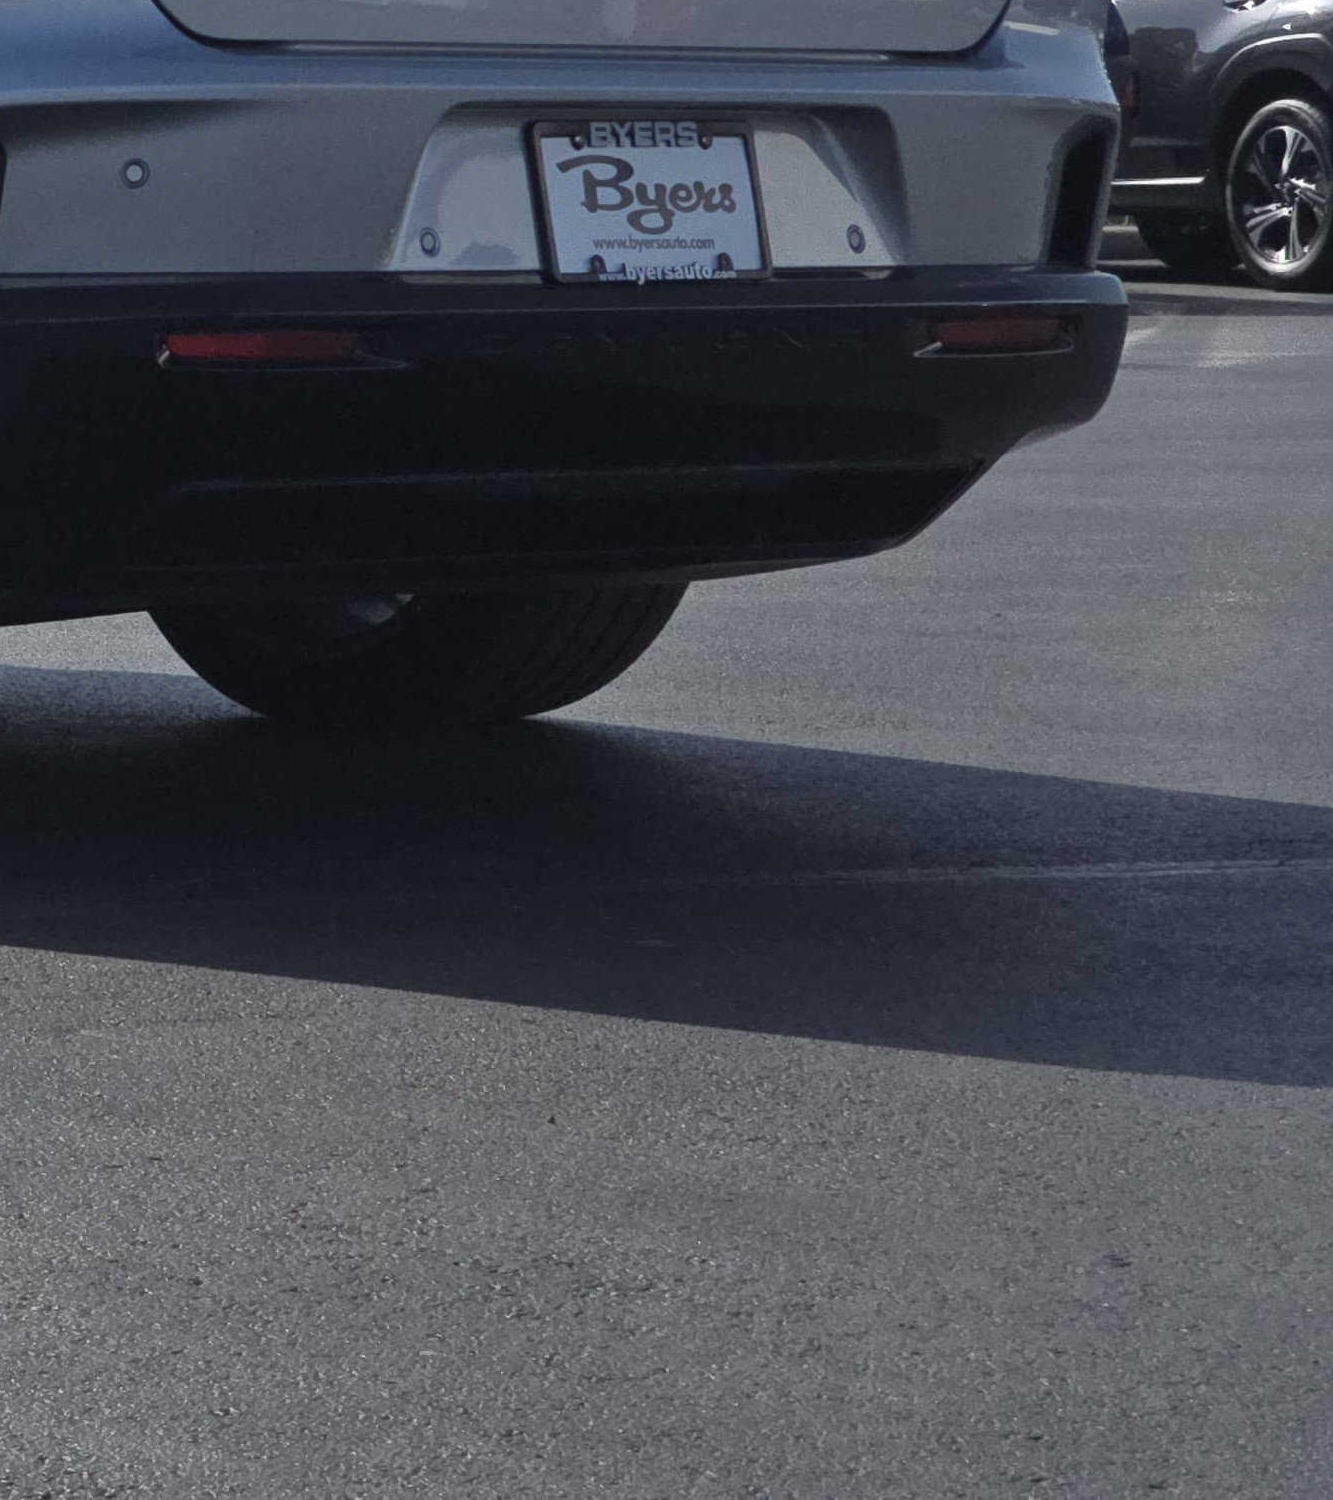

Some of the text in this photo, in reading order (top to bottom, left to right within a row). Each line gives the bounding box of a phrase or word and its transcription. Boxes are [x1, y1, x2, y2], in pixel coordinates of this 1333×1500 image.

[589, 121, 699, 147] BYERS
[556, 155, 736, 235] Byers
[593, 236, 715, 253] www.byersauto.com
[598, 262, 737, 285] www.byersauto.com
